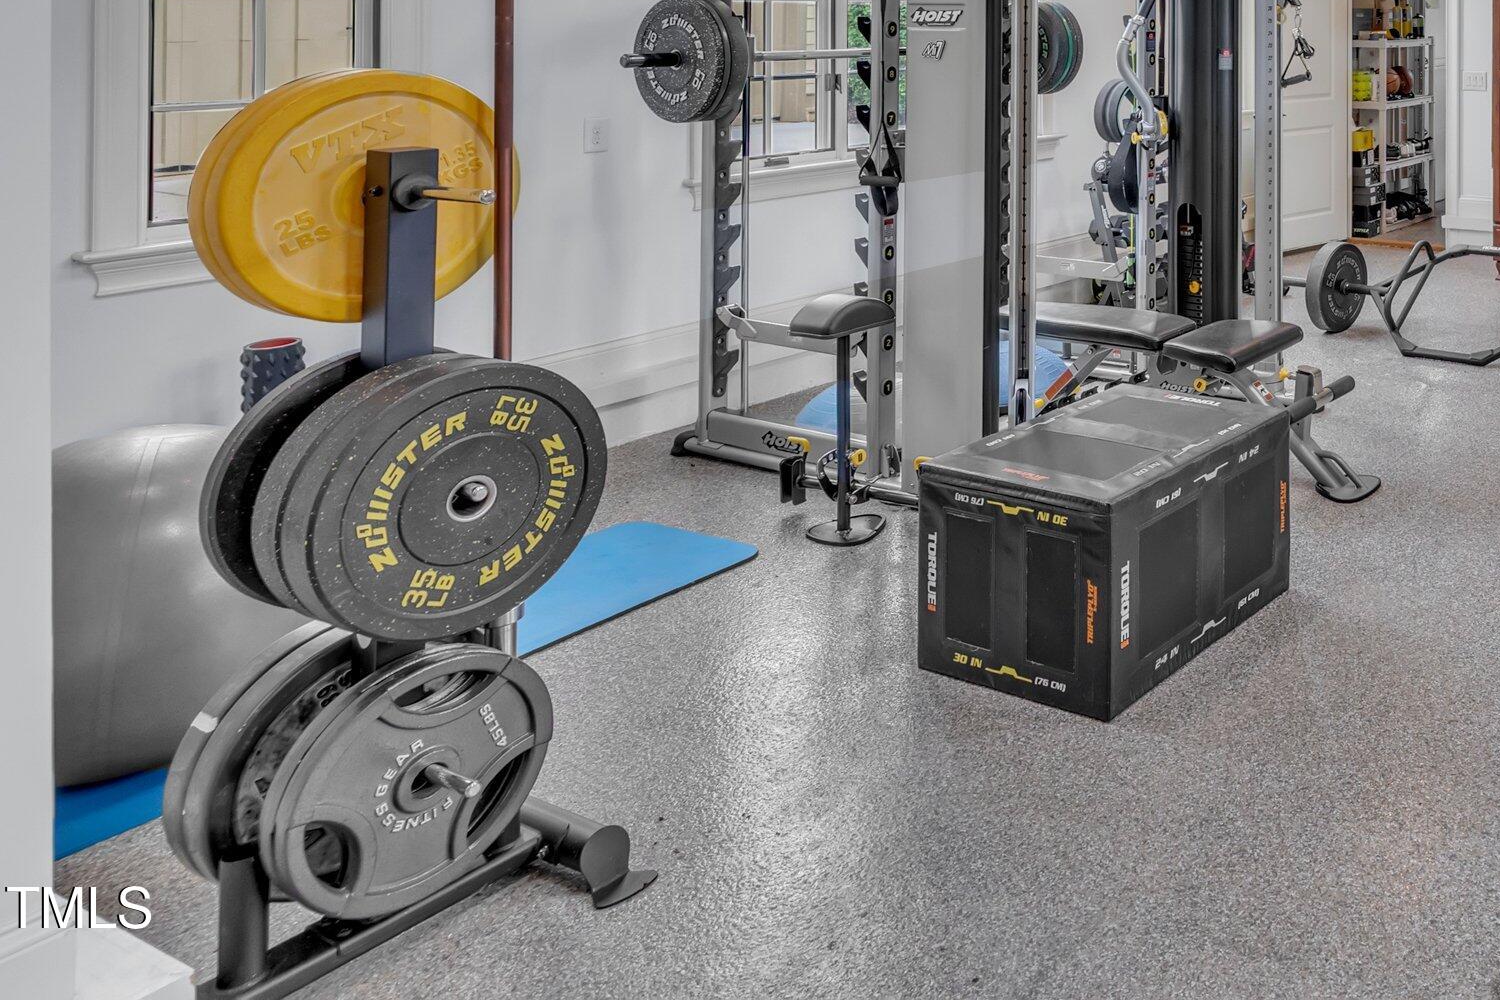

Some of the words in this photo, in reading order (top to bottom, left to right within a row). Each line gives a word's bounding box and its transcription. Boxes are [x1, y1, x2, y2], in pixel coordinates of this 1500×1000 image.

[912, 10, 962, 23] HOIST
[290, 104, 405, 174] VTX
[273, 209, 315, 238] 25
[279, 224, 332, 258] LBS
[490, 395, 516, 427] LB
[506, 396, 538, 433] 35
[1036, 511, 1050, 523] IN
[1052, 513, 1068, 527] 30
[927, 532, 938, 606] TORQUE
[401, 568, 437, 608] 35
[427, 574, 456, 608] LB
[1120, 560, 1130, 640] TORQUE
[952, 652, 968, 665] 30
[970, 657, 983, 669] IN
[1034, 675, 1049, 688] (76
[1050, 680, 1067, 693] CM)
[375, 739, 424, 798] GEAR
[375, 797, 453, 833] FITNESS
